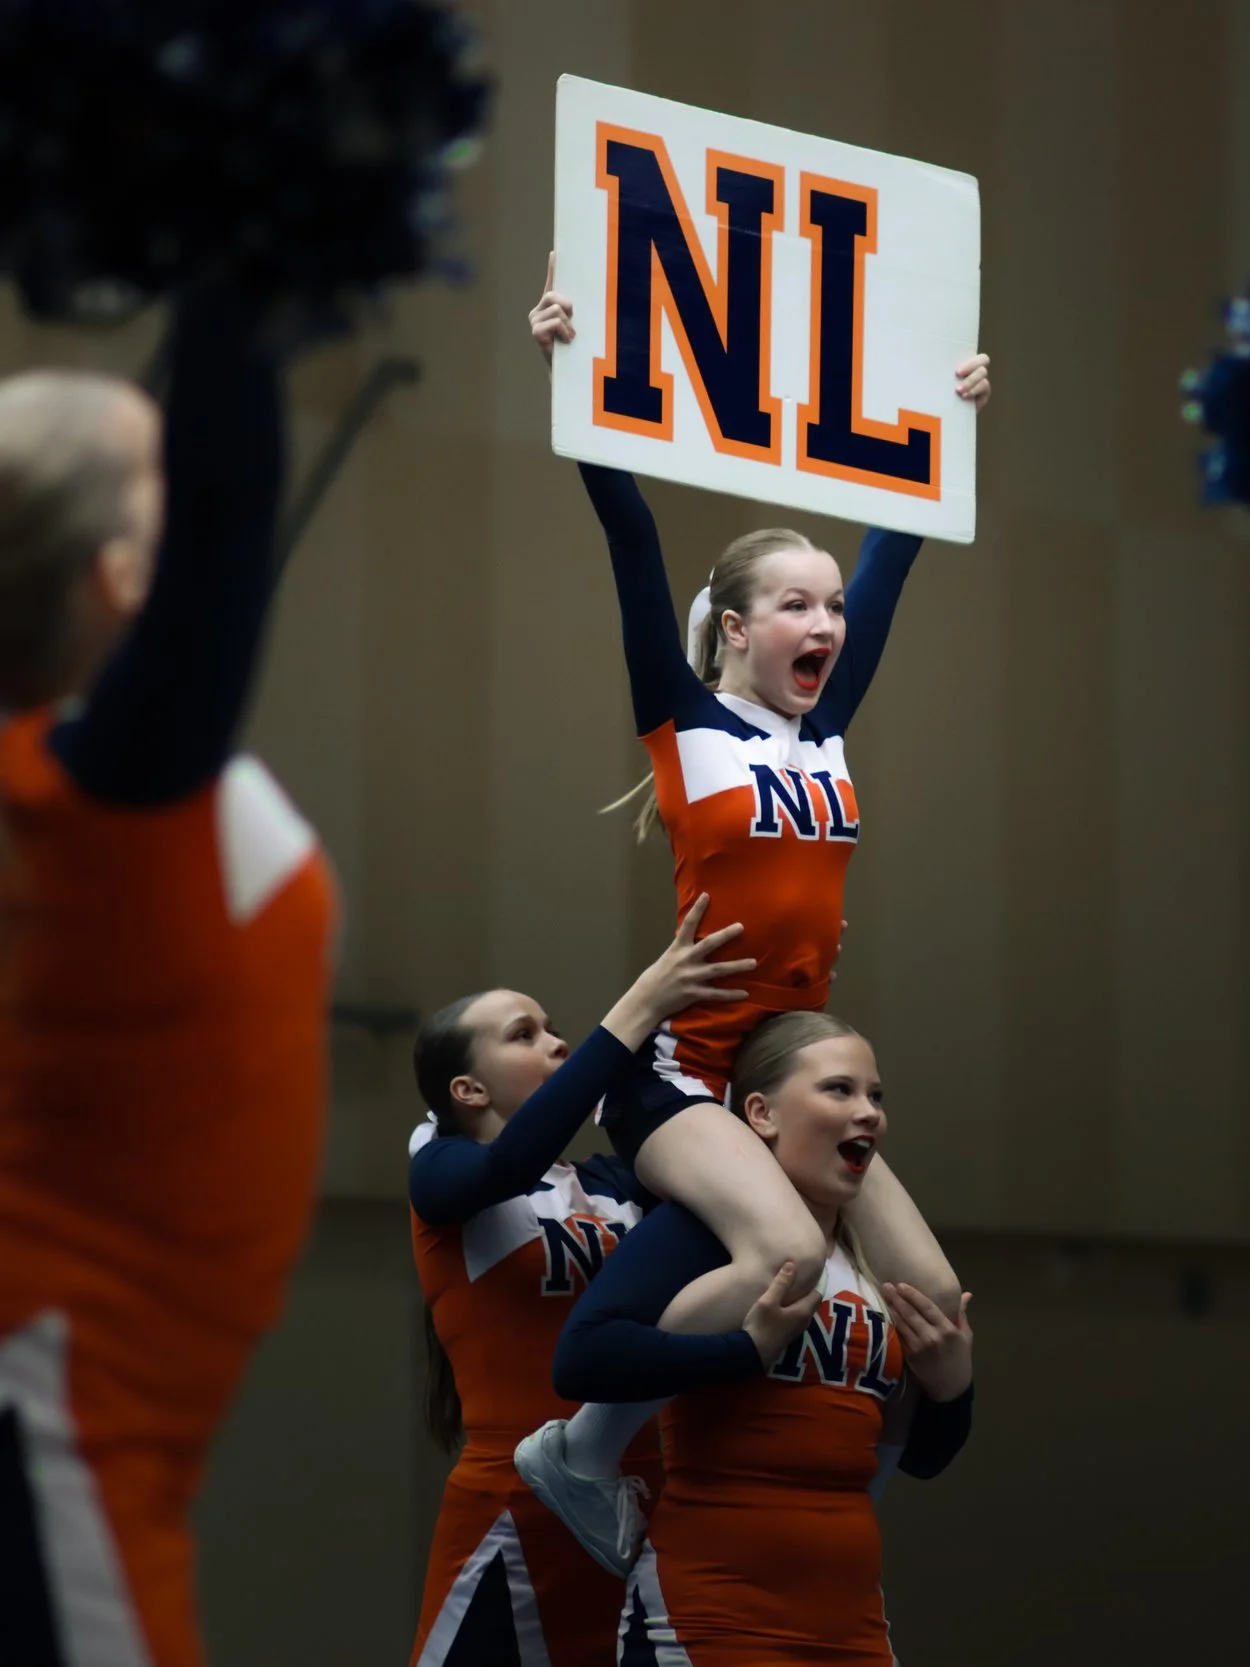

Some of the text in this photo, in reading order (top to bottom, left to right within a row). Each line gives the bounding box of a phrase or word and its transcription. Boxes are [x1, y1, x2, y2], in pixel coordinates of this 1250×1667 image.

[593, 120, 941, 502] NL
[749, 763, 859, 844] NL
[537, 1216, 628, 1296] N
[767, 1298, 899, 1401] NL
